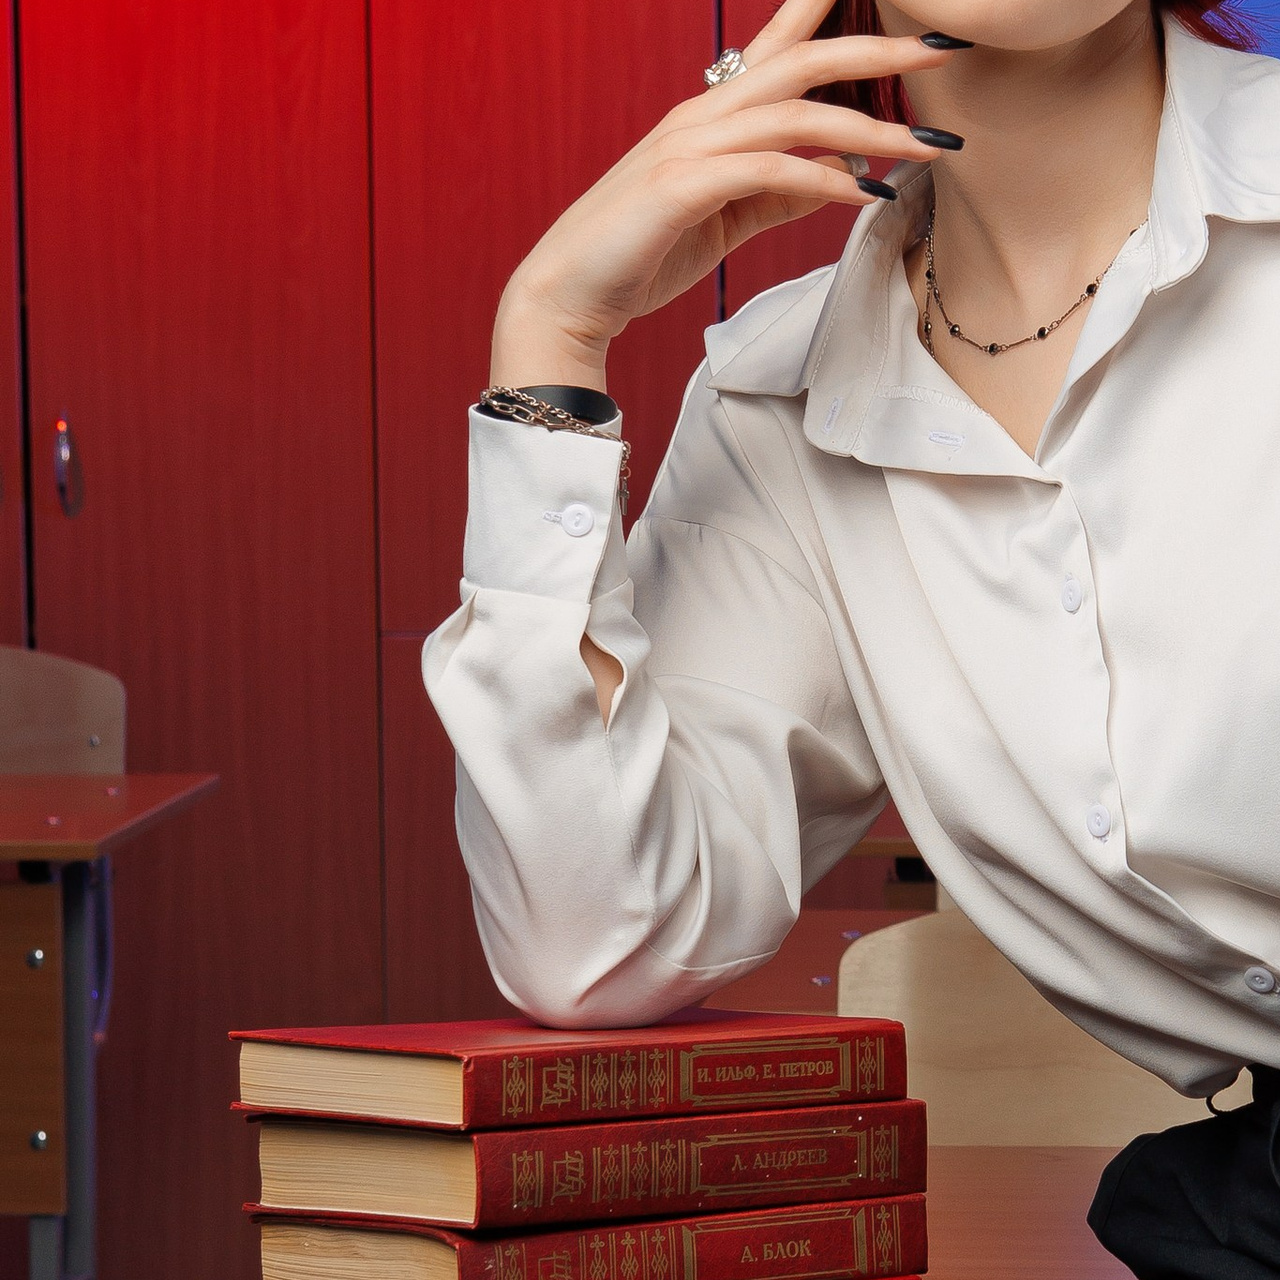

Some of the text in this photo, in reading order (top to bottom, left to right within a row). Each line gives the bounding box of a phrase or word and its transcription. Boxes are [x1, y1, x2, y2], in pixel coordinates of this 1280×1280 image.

[697, 1060, 834, 1082] И. ИЛЬФ, Е. ПЕТРОВ
[731, 1148, 828, 1171] Л. АНДРЕЕВ
[740, 1239, 812, 1263] А. БЛОК
